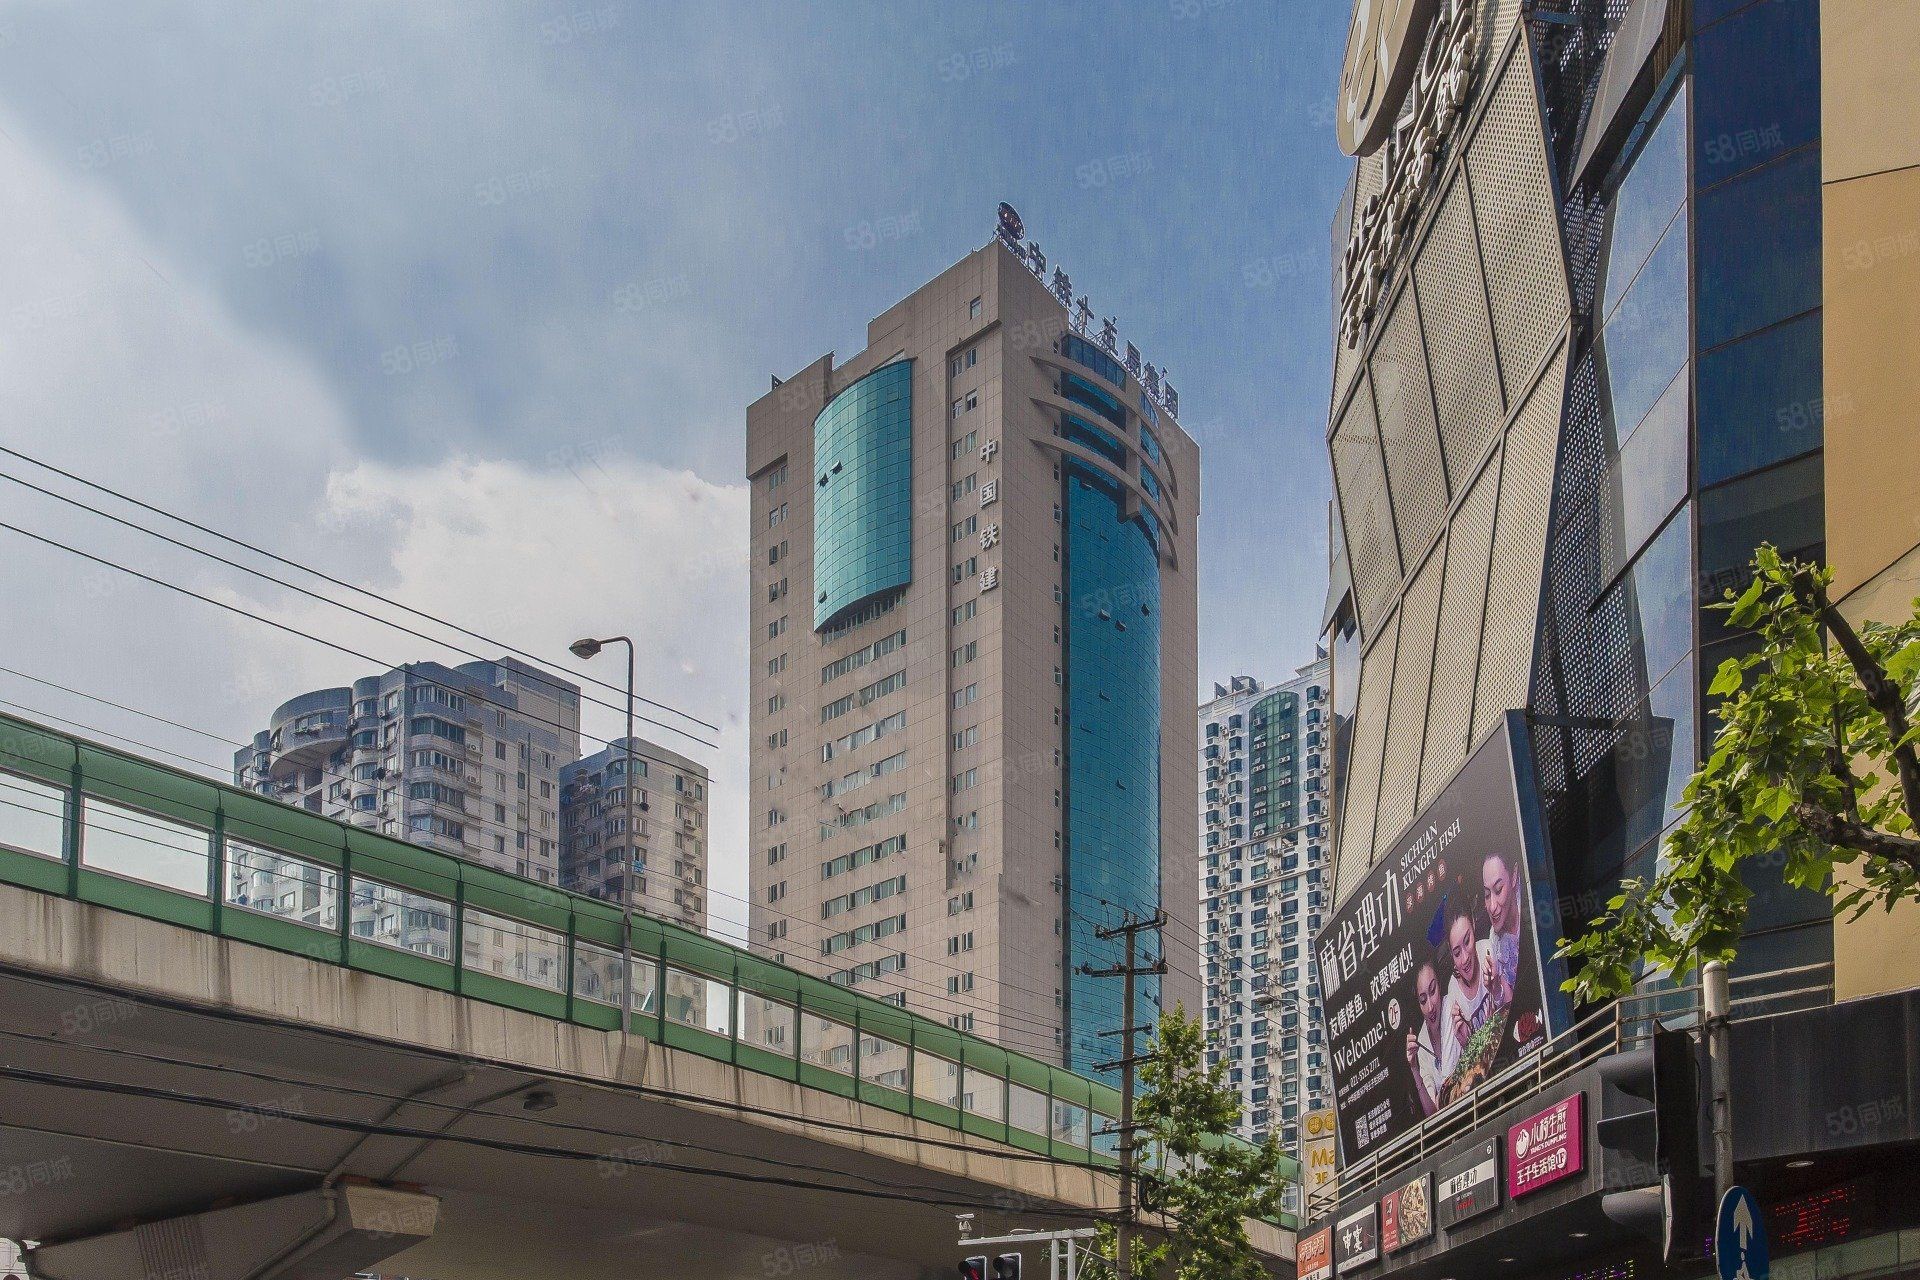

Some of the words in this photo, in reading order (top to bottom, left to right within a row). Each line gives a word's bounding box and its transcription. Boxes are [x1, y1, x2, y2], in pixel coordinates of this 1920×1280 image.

[980, 439, 999, 594] 中国铁建
[1400, 821, 1438, 871] SICHUAN
[1402, 845, 1438, 890] KUNGFU
[1439, 817, 1461, 851] FISH
[1320, 869, 1401, 1001] 麻省理功
[1333, 1010, 1388, 1074] Welcome!
[1389, 1002, 1399, 1027] 2F
[1315, 1171, 1328, 1184] 3F
